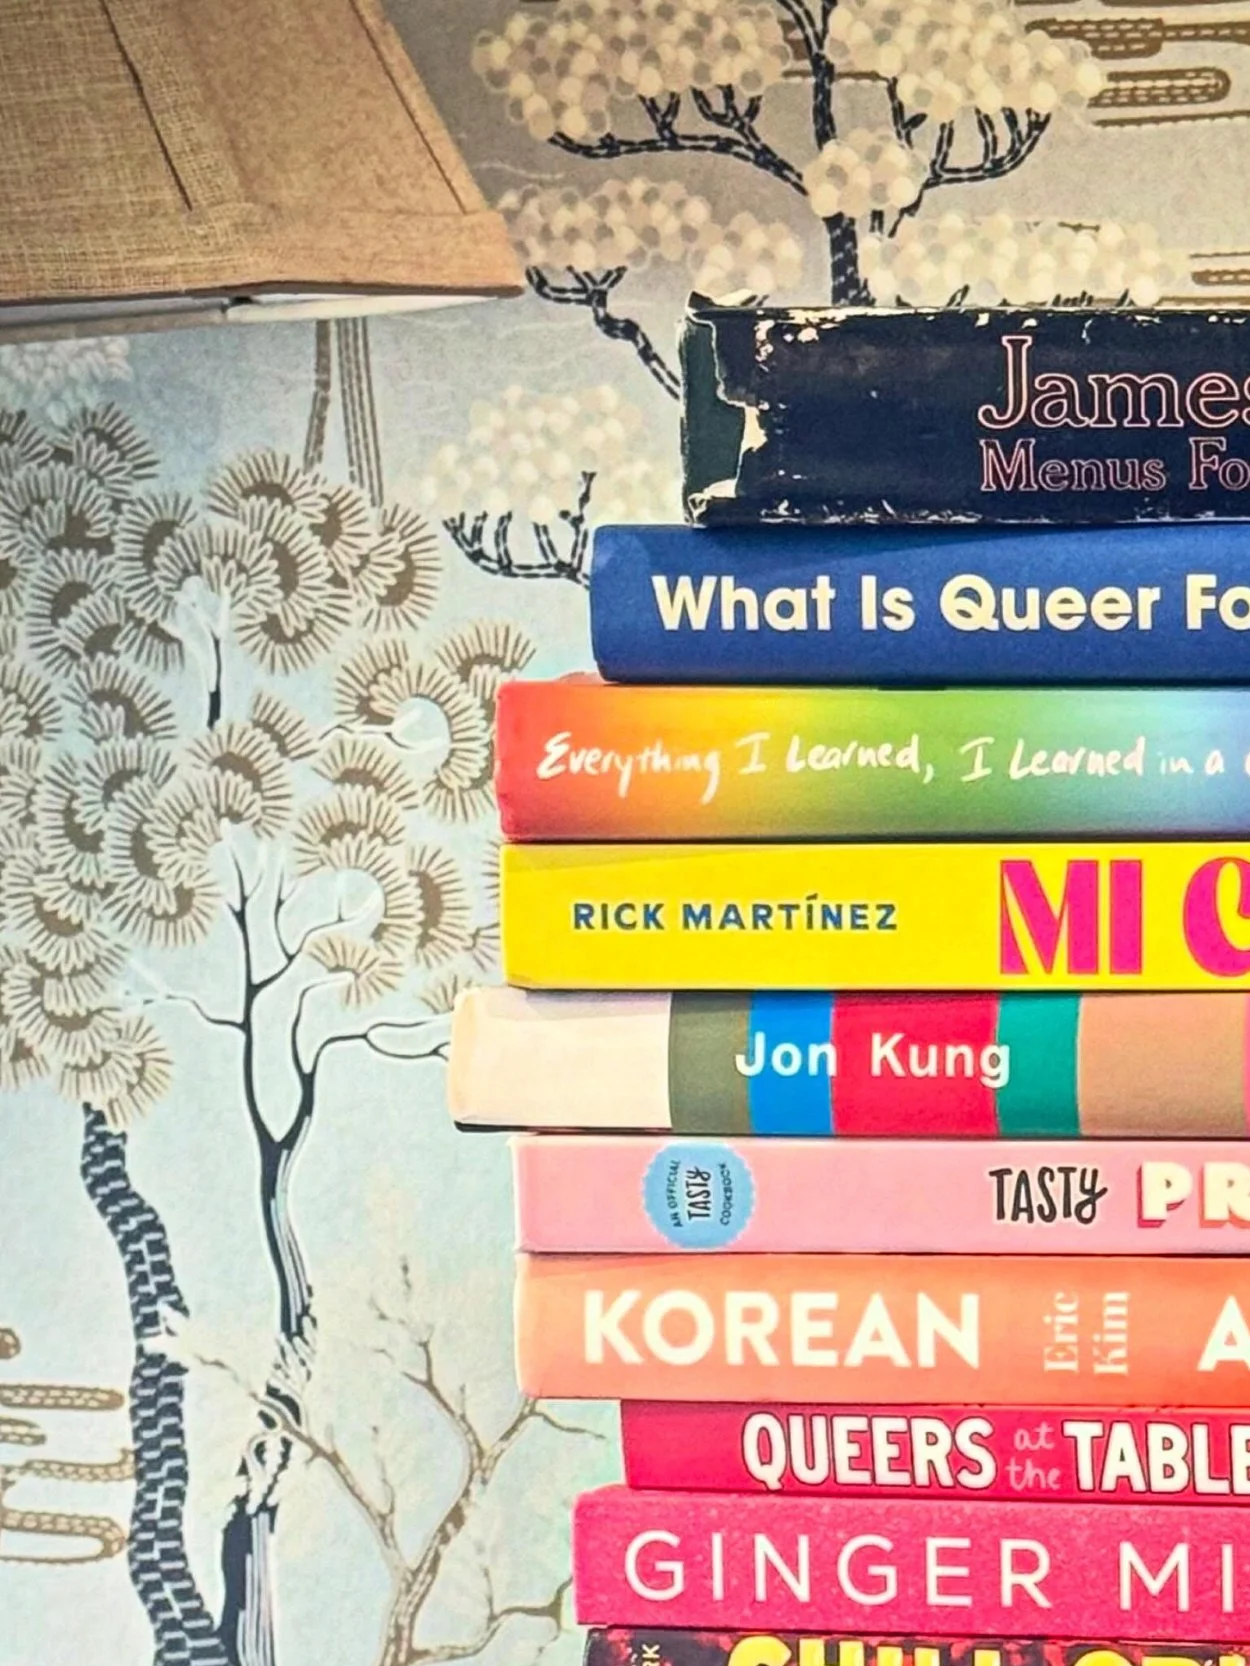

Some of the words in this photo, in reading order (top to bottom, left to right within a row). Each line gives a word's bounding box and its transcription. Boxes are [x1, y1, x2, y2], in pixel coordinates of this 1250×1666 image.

[980, 438, 1167, 492] Menus
[652, 575, 835, 632] What
[861, 575, 915, 632] Is
[940, 573, 1160, 633] Queer
[536, 731, 721, 805] Everything
[734, 732, 771, 775] I
[785, 734, 934, 784] Learned,
[959, 737, 995, 783] I
[1009, 736, 1145, 780] Learned
[1159, 749, 1193, 775] in
[1204, 751, 1226, 776] a
[573, 902, 665, 931] RICK
[681, 894, 898, 932] MARTÍNEZ
[999, 858, 1143, 976] MI
[735, 1031, 837, 1077] Jon
[869, 1032, 1011, 1089] Kung
[685, 1166, 711, 1220] TASTY
[988, 1165, 1109, 1225] TASTY
[584, 1289, 980, 1370] KOREAN
[1042, 1292, 1079, 1374] Eric
[1092, 1292, 1129, 1376] Kim
[742, 1411, 997, 1492] QUEERS
[1013, 1422, 1055, 1451] at
[1005, 1456, 1061, 1492] the
[624, 1529, 1051, 1610] GINGER
